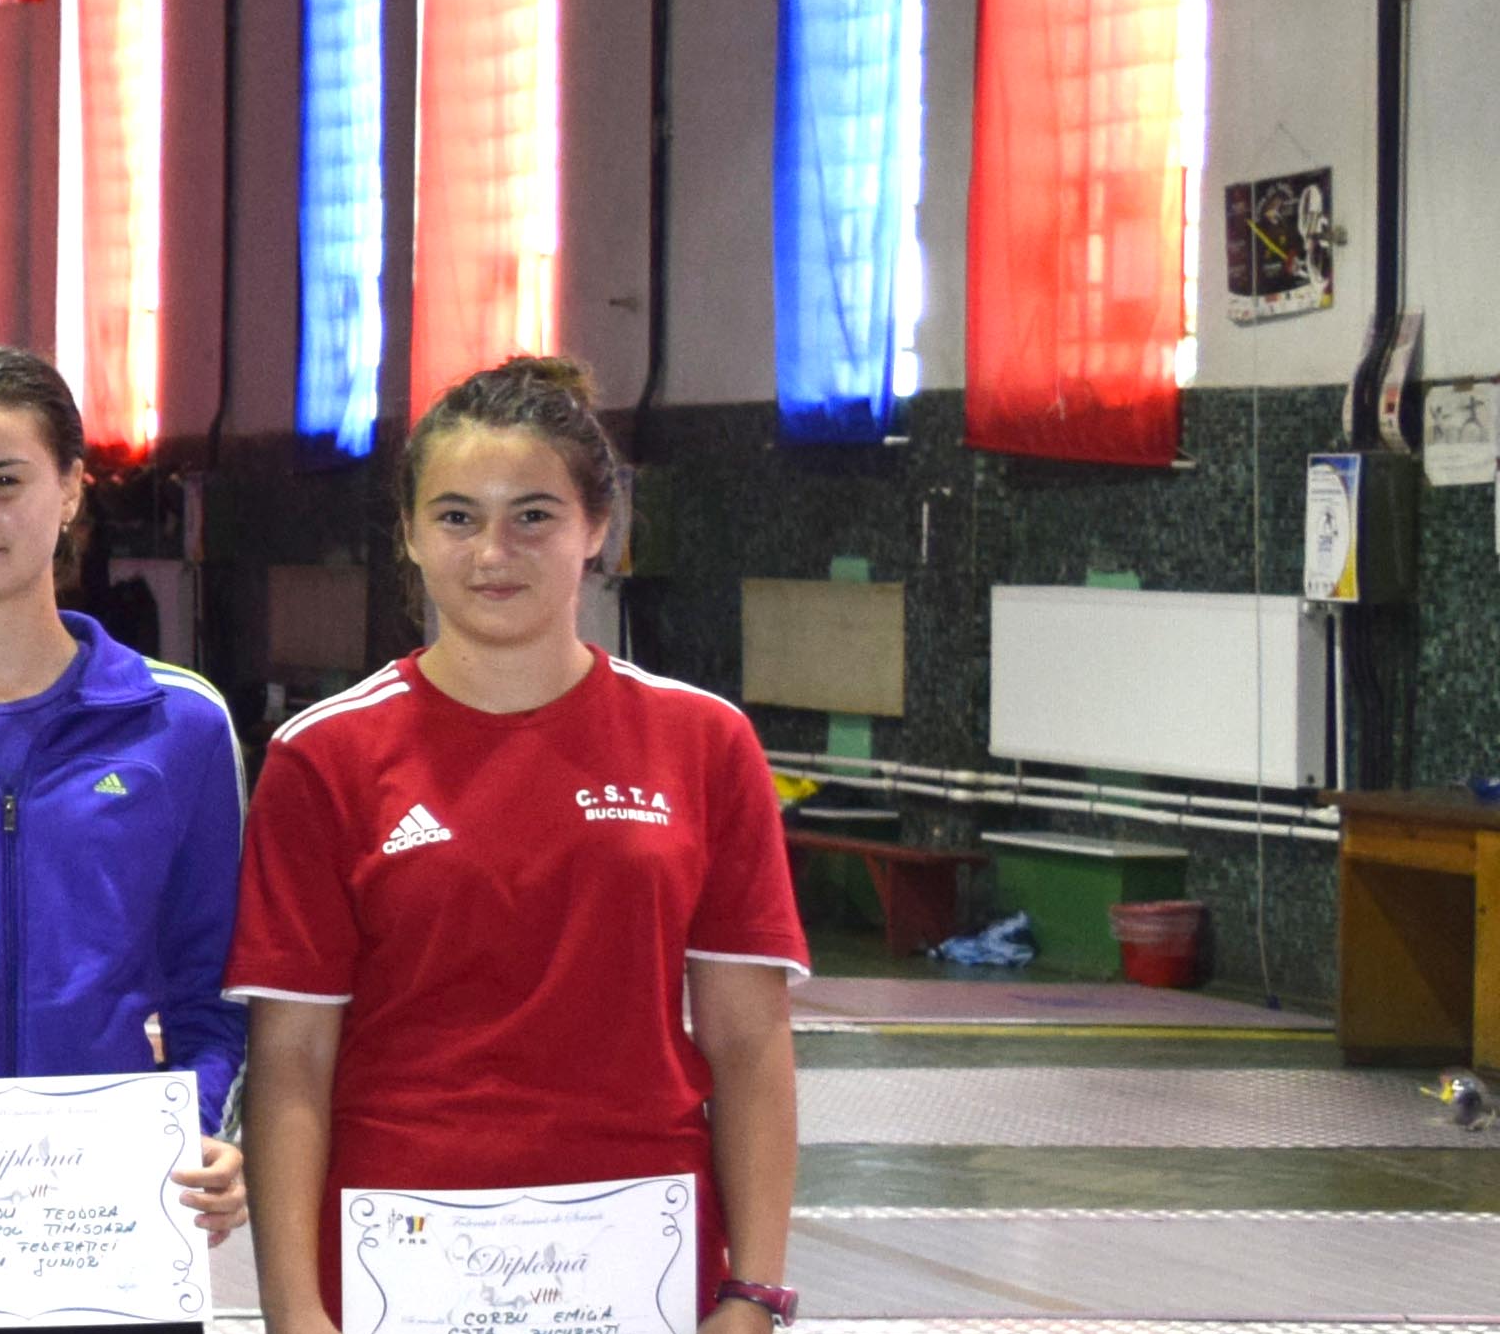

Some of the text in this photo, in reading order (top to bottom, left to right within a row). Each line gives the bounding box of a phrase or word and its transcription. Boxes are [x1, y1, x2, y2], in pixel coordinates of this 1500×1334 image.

[584, 807, 668, 825] BUCURESTI
[382, 828, 452, 854] adidas
[43, 1205, 119, 1221] TEODORA
[463, 1311, 529, 1326] CORBU
